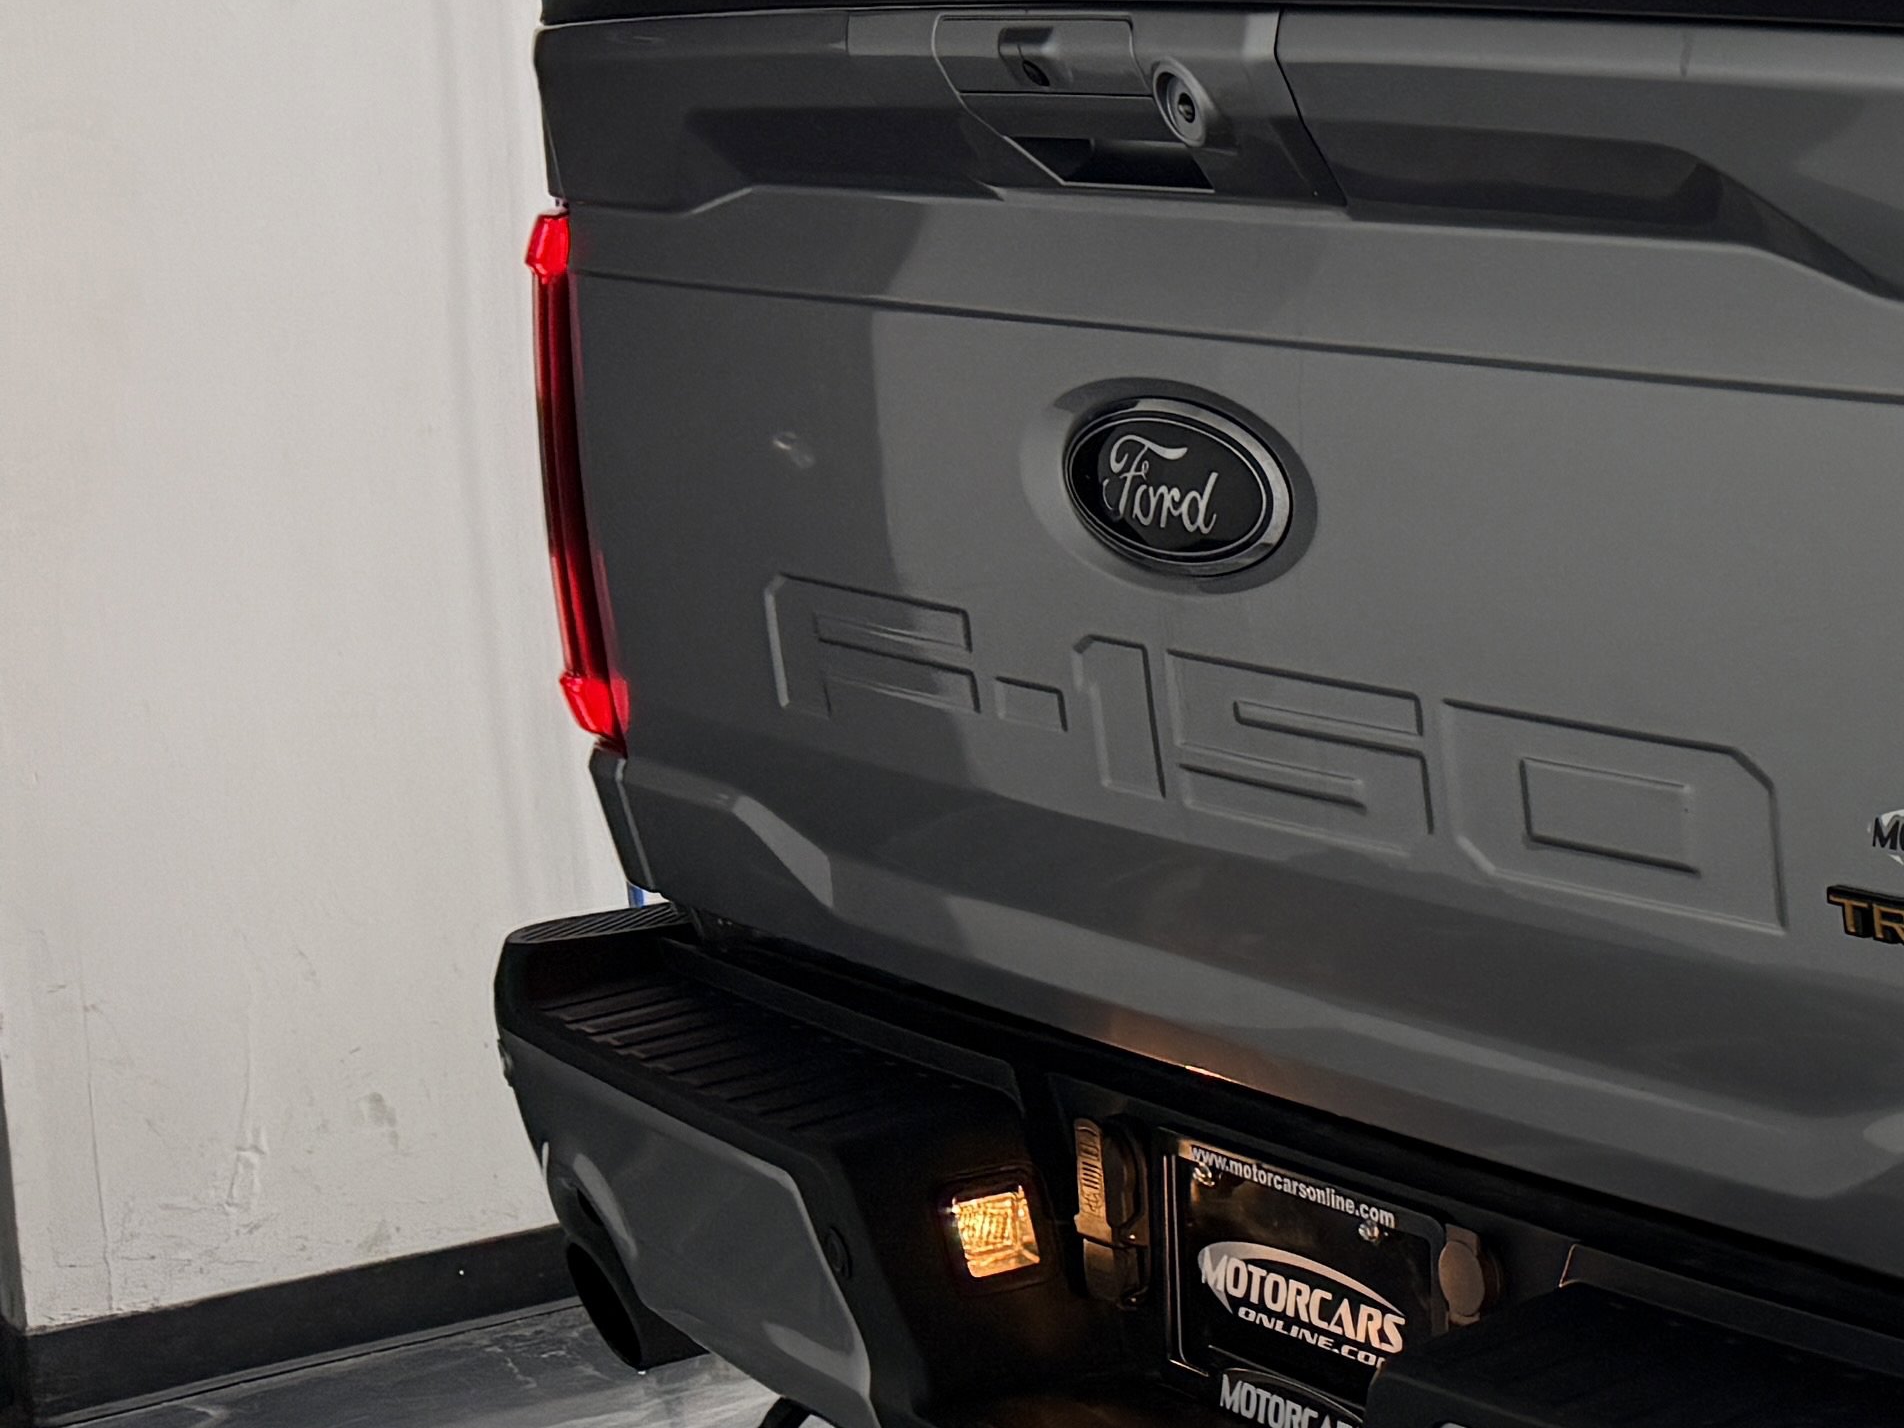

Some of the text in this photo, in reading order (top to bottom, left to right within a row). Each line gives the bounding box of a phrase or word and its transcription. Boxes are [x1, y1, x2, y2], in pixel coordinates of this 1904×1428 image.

[1102, 434, 1219, 534] Ford
[764, 574, 1788, 936] F-150
[1191, 1145, 1396, 1228] www.motorcarsonline.com
[1201, 1247, 1406, 1354] MOTORCARS
